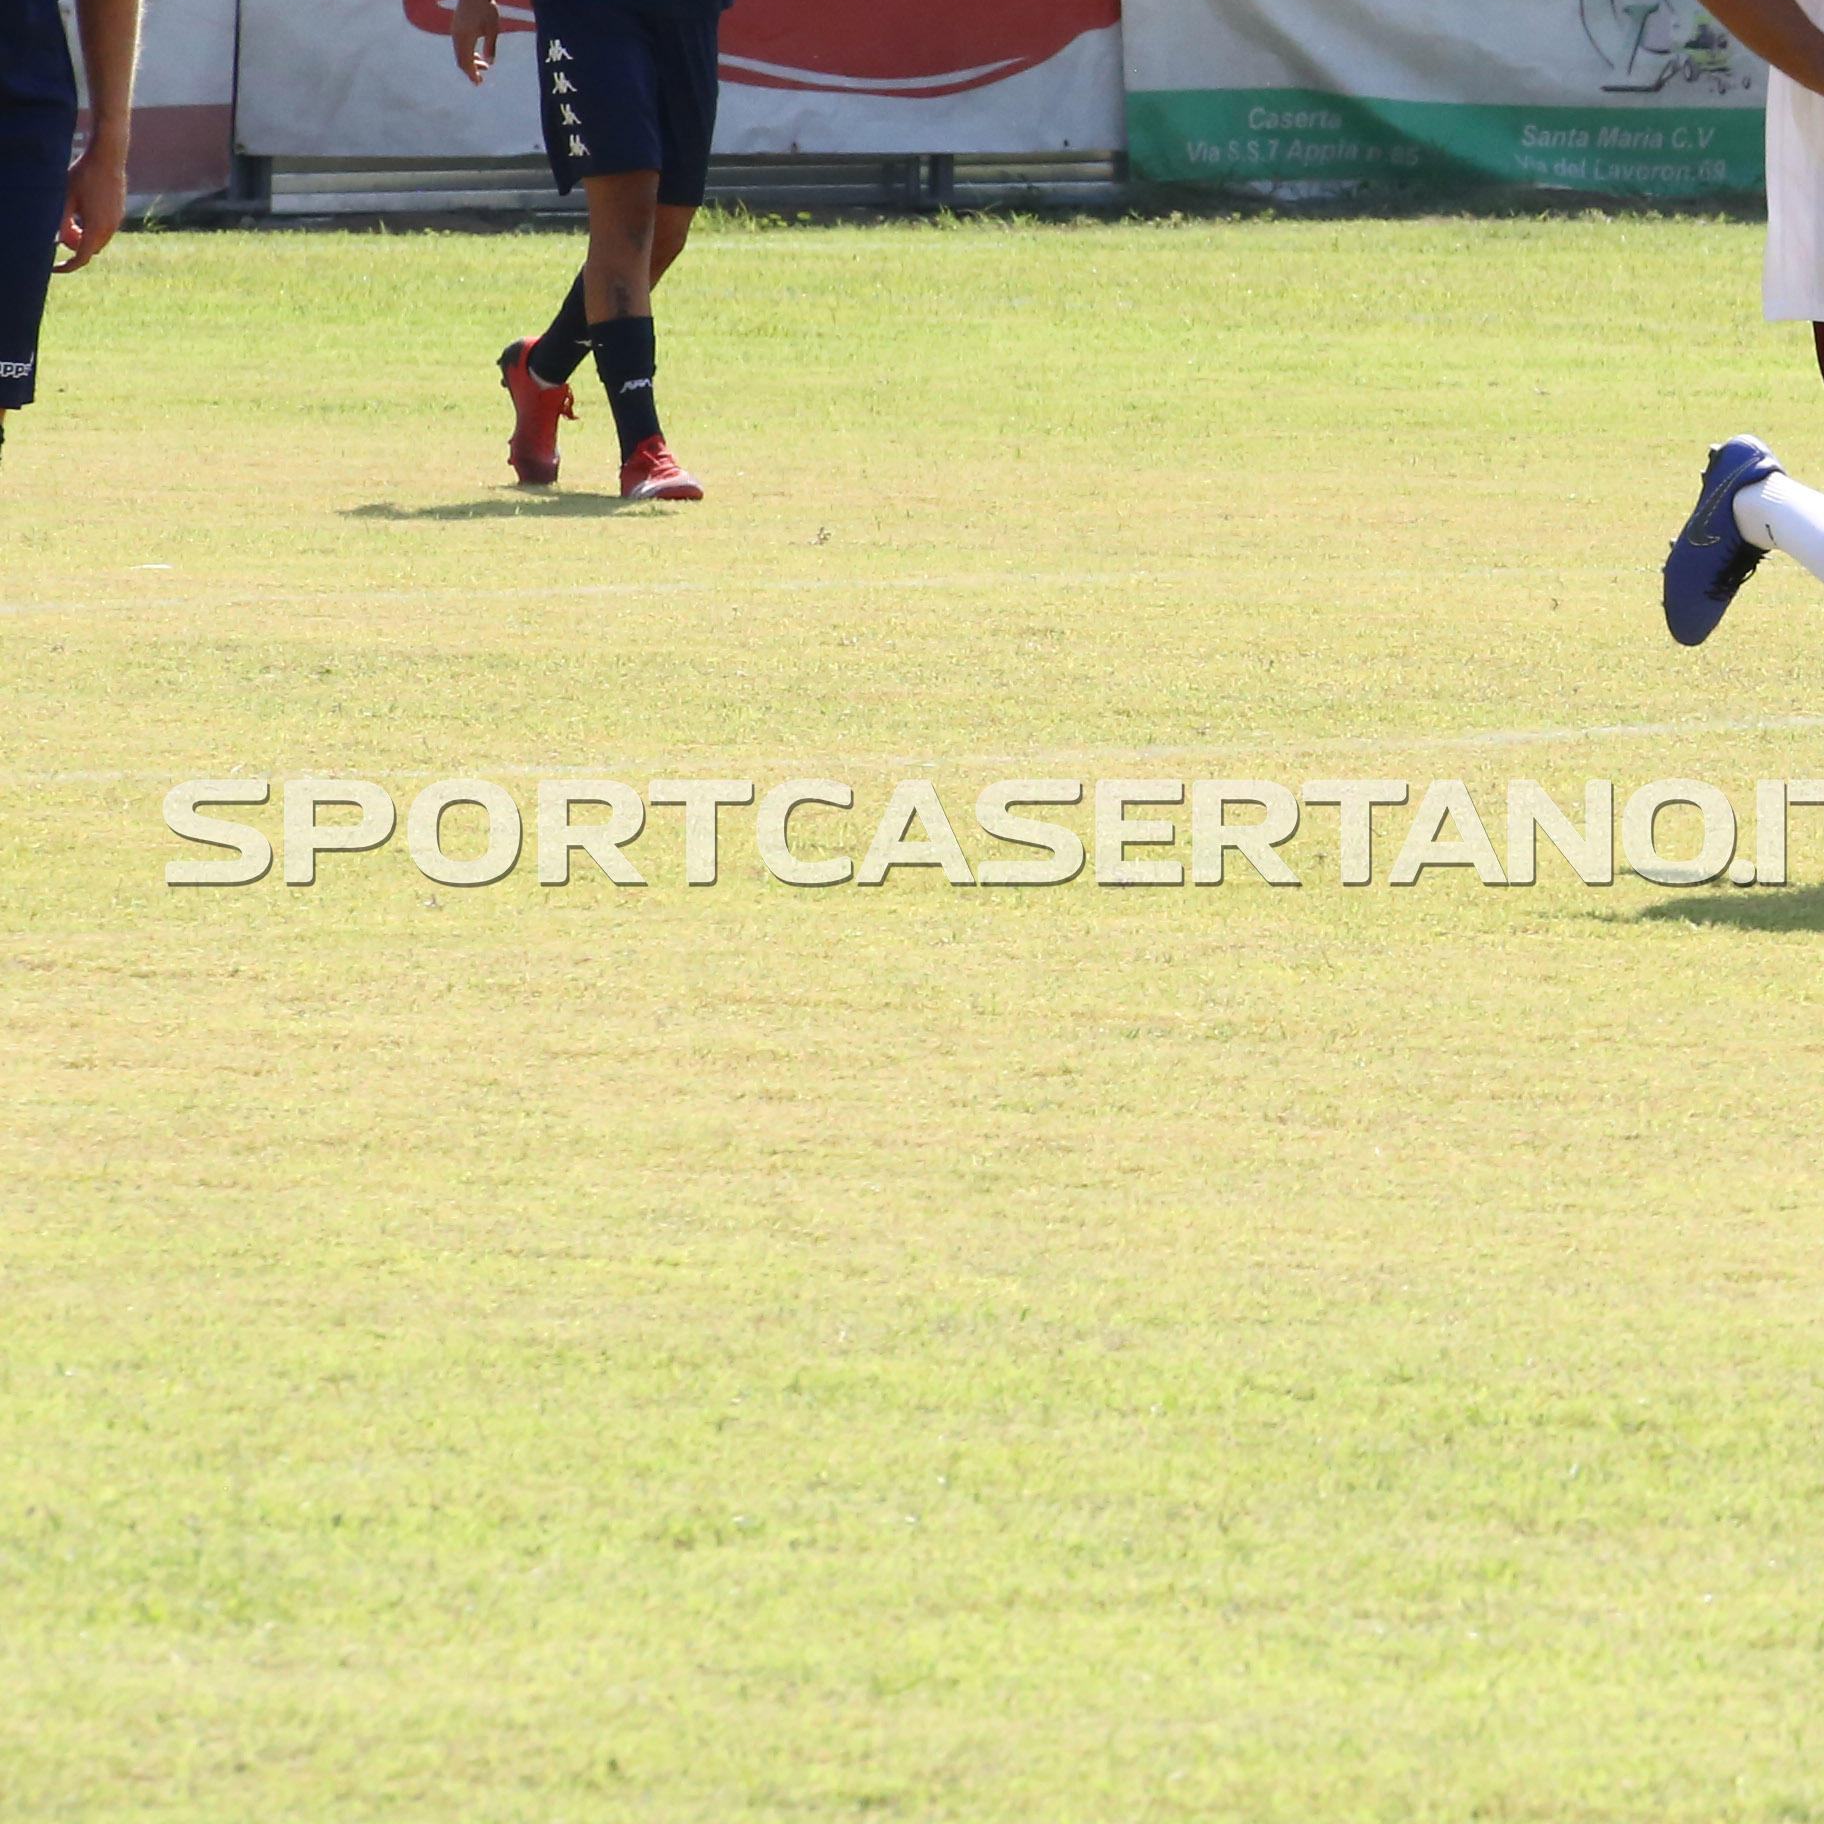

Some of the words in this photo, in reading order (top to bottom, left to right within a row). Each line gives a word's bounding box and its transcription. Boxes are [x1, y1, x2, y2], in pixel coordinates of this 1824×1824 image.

[1248, 106, 1344, 130] Caserta
[1521, 124, 1589, 148] Santa
[1597, 126, 1664, 149] Maria
[1187, 140, 1221, 163] Via
[1286, 139, 1360, 166] Appia
